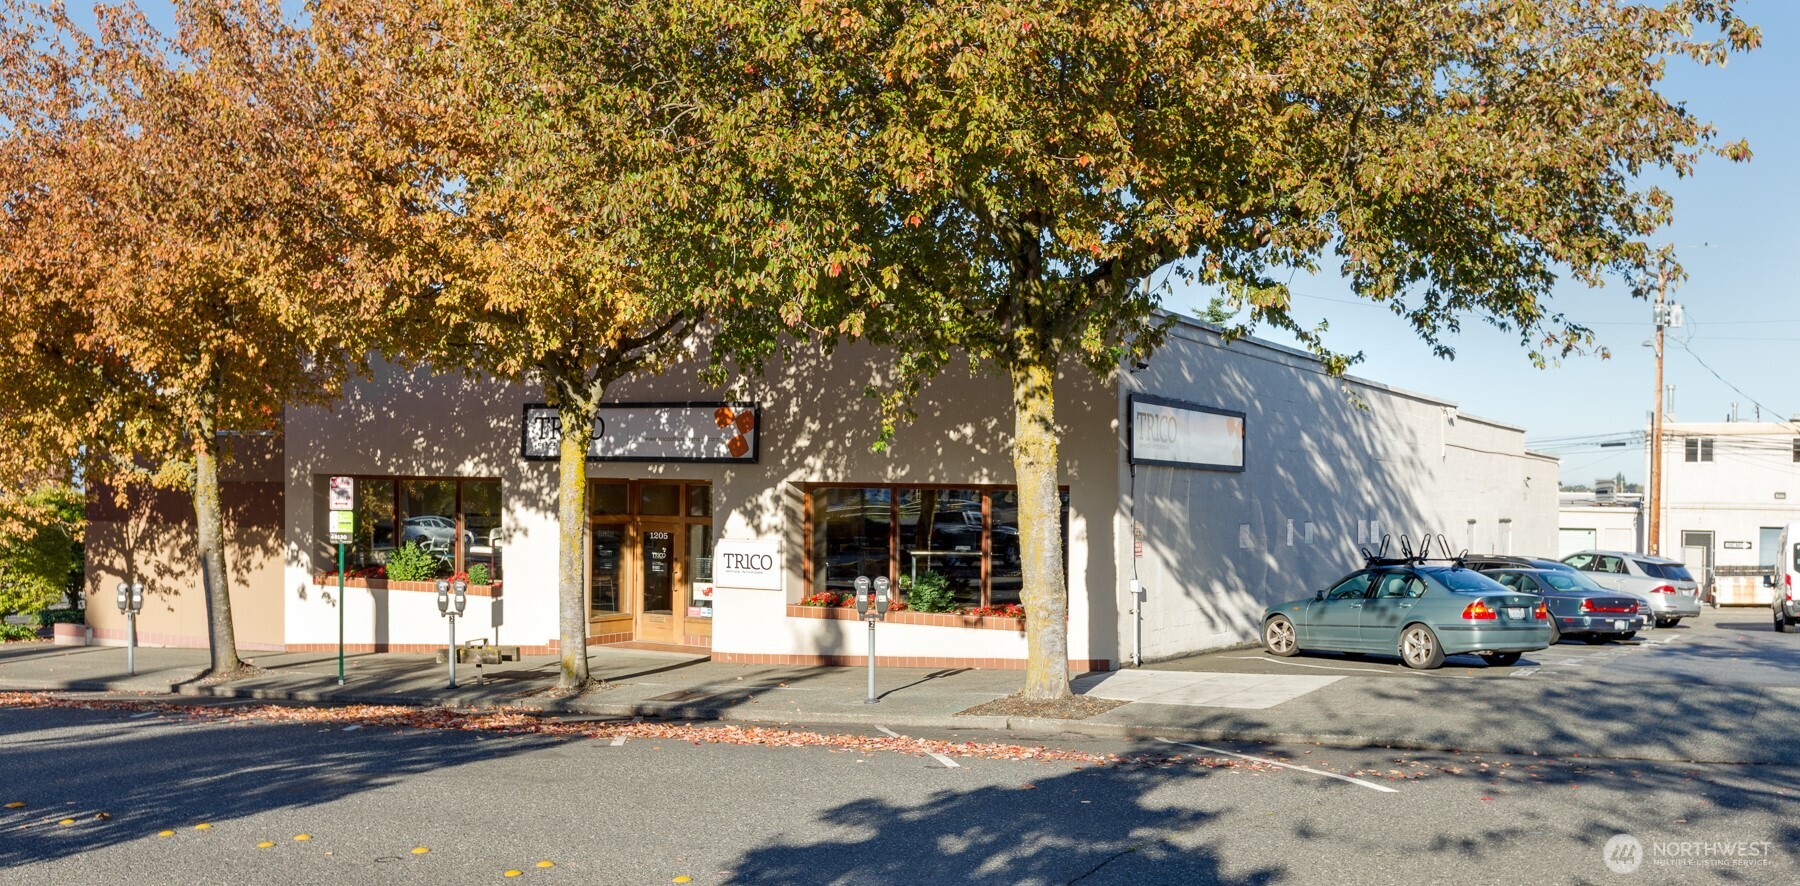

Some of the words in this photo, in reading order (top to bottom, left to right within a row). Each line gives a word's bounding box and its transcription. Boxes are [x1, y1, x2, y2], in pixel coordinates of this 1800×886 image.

[535, 416, 605, 440] TRO
[1137, 412, 1177, 443] TRICO
[650, 532, 668, 540] 1205
[723, 553, 773, 570] TRICO
